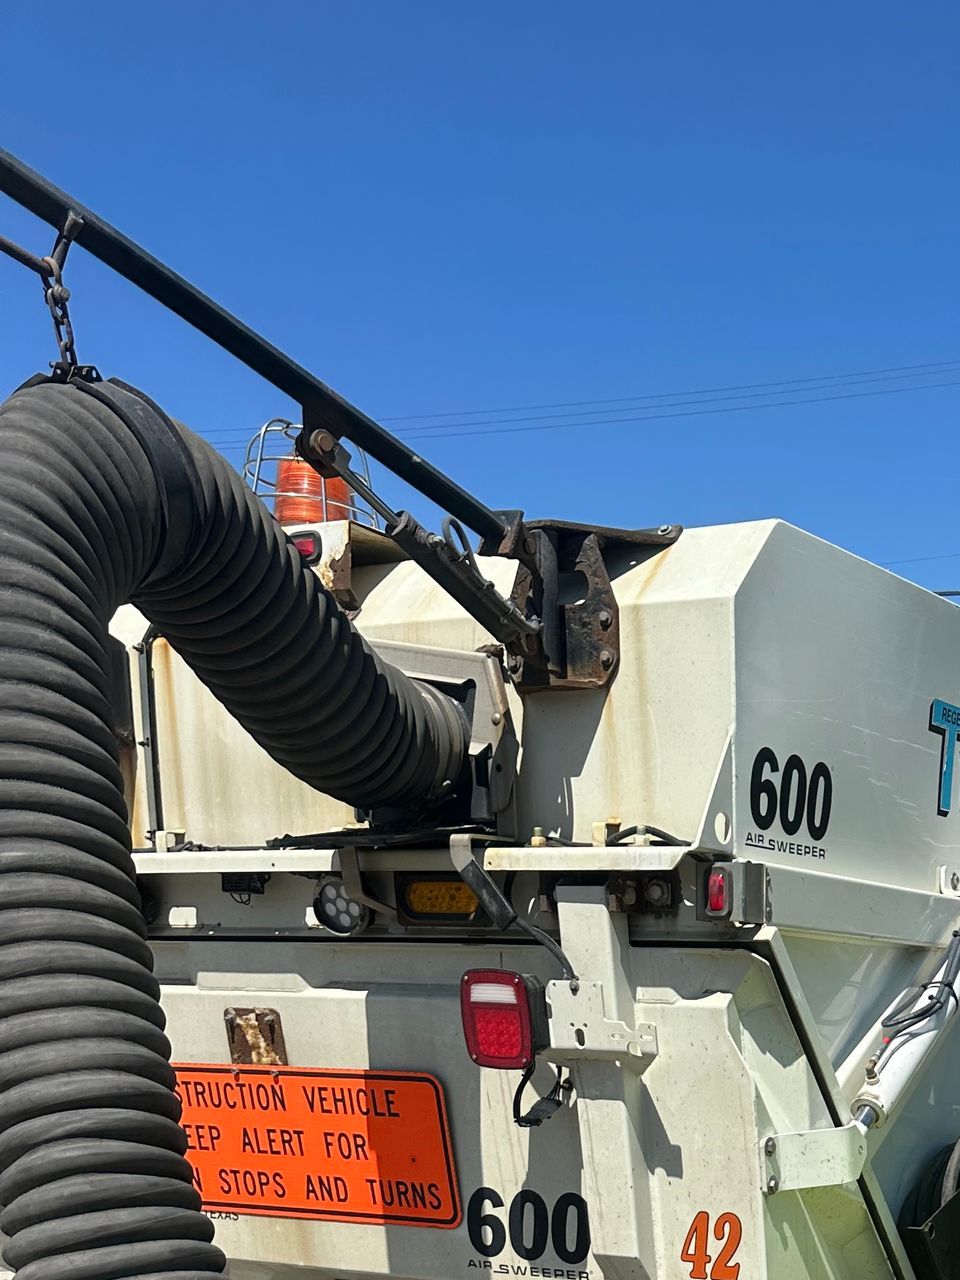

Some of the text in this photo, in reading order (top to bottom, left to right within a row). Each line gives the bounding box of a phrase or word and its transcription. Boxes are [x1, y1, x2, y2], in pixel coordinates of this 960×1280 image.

[750, 747, 833, 841] 600
[745, 832, 827, 860] AIR SWEEPER
[302, 1086, 400, 1117] VEHICLE
[242, 1127, 304, 1156] ALERT
[324, 1132, 368, 1160] FOR
[218, 1168, 286, 1198] STOPS
[306, 1174, 348, 1203] AND
[365, 1178, 442, 1210] TURNS
[467, 1186, 591, 1264] 600
[467, 1259, 493, 1270] AIR
